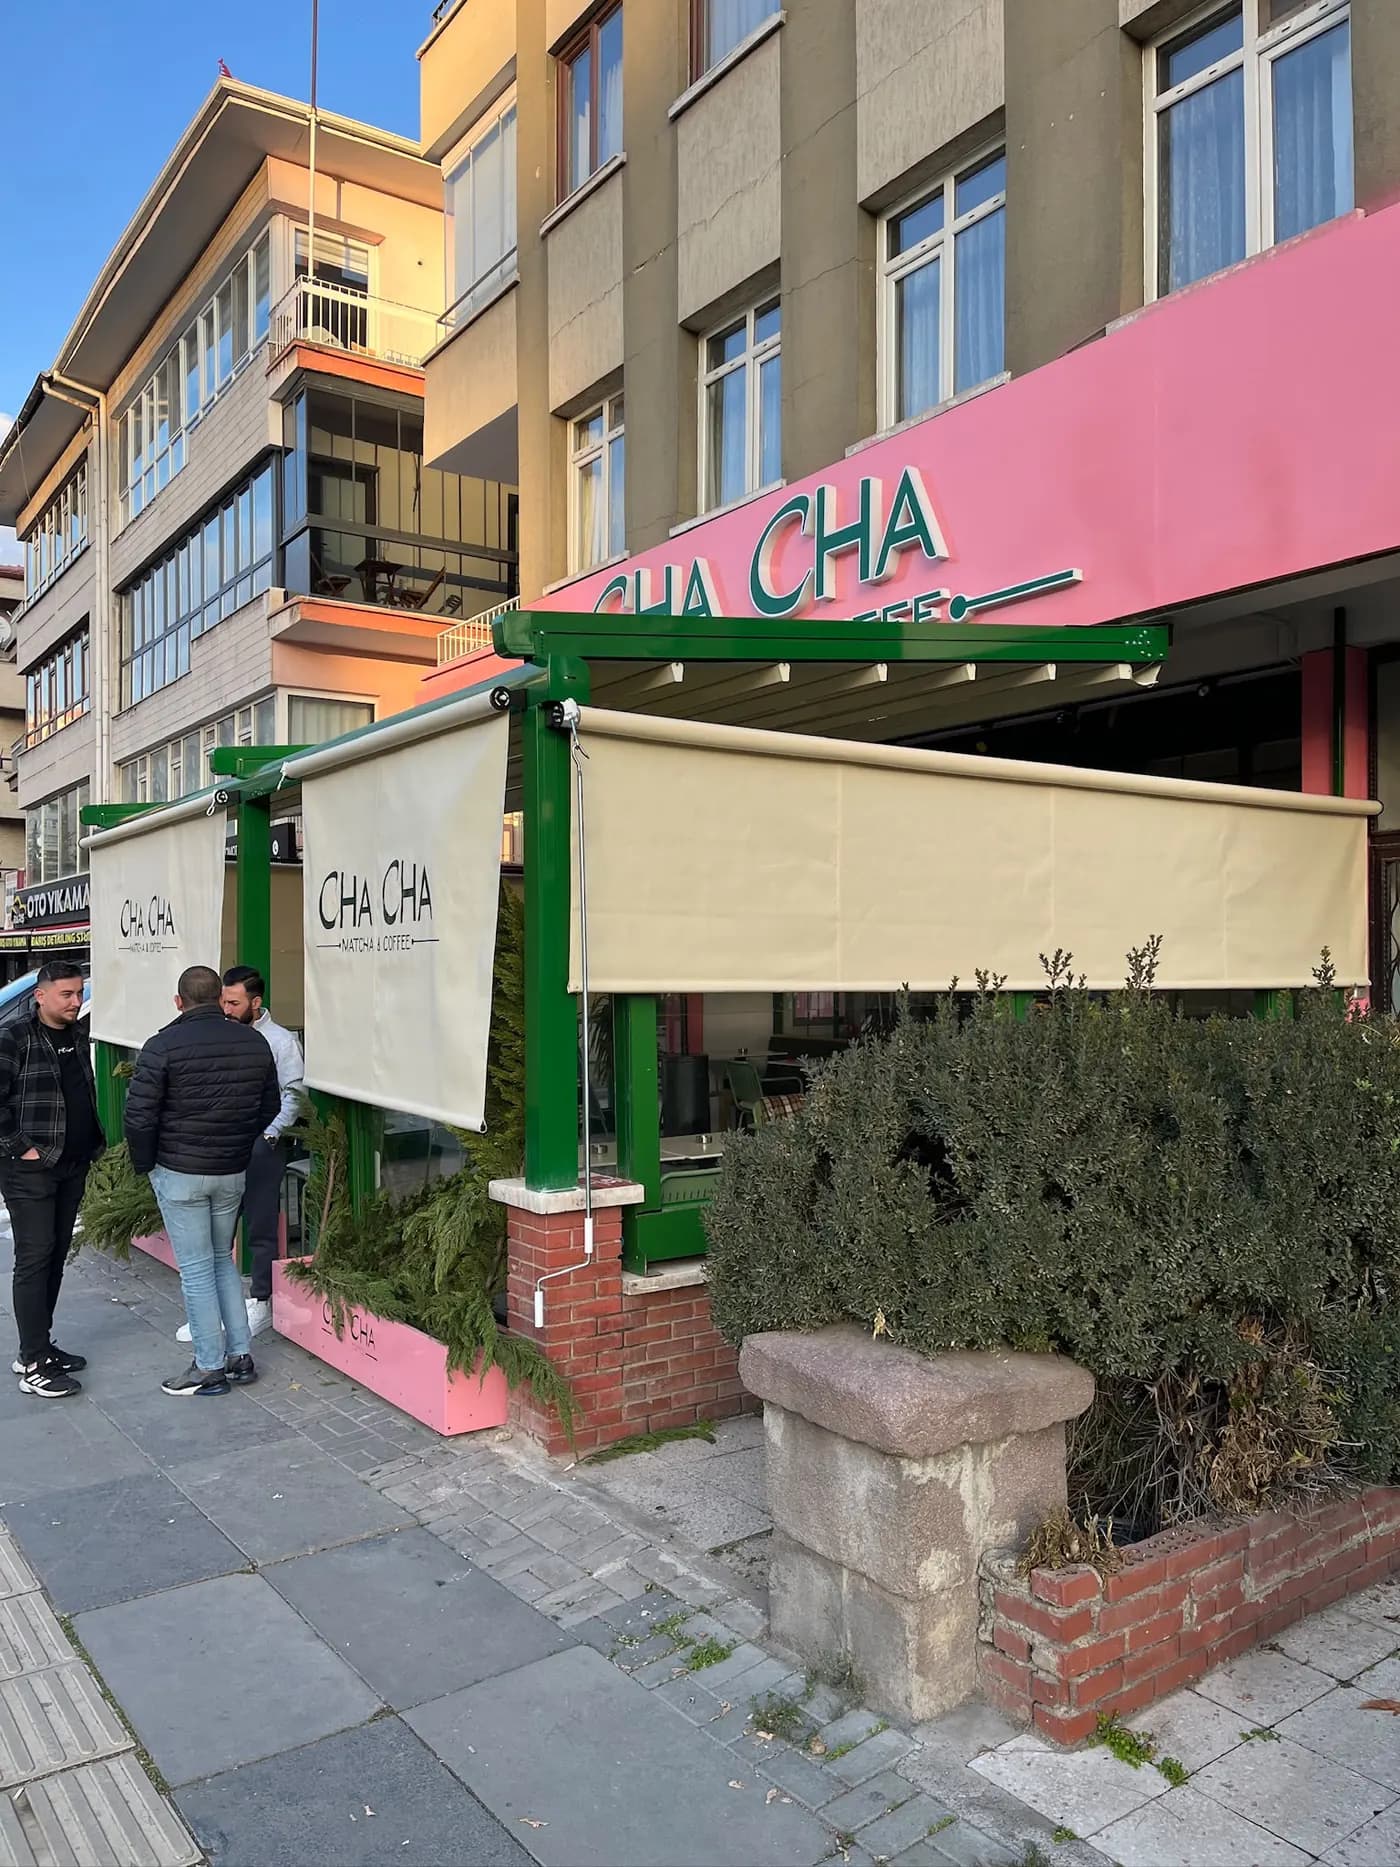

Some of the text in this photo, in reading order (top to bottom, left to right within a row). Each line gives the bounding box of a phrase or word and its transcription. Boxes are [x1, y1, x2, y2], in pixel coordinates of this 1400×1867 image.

[749, 465, 947, 617] CHA
[27, 882, 90, 918] OTO YIKAMA
[319, 859, 433, 930] CHA CHA
[120, 895, 175, 938] CHA CHA
[341, 938, 374, 953] MATCHA
[383, 934, 411, 952] COFFEE
[351, 1314, 376, 1351] CHA
